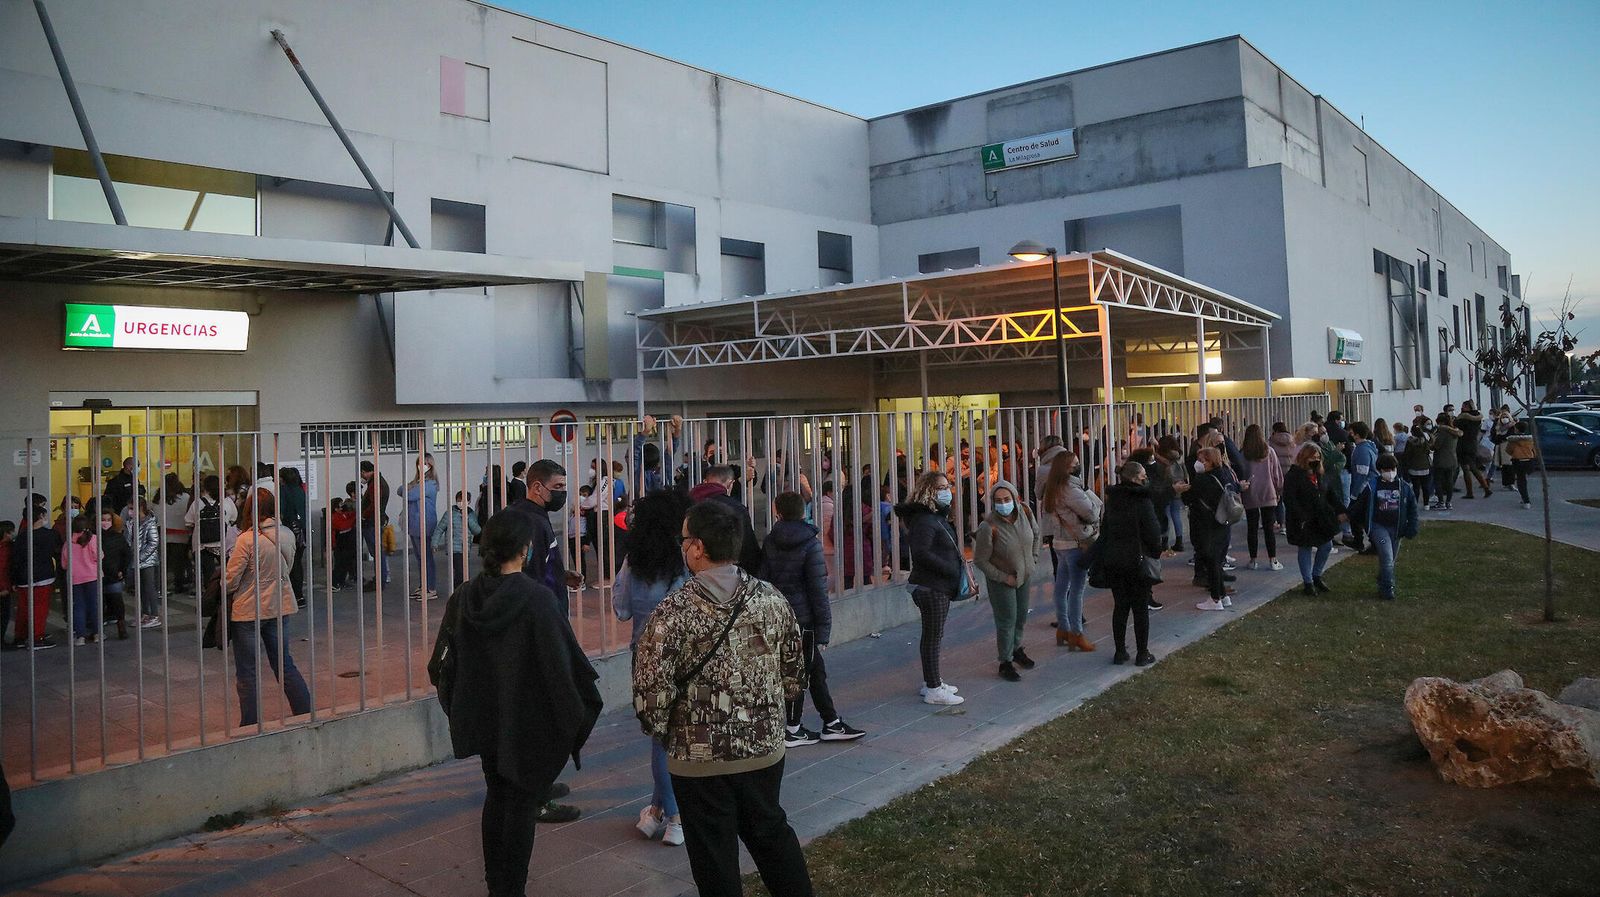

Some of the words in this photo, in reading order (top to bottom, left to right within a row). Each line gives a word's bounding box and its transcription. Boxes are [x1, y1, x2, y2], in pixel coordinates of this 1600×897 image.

[1007, 145, 1030, 154] Centro
[1030, 142, 1039, 150] de
[1039, 138, 1059, 148] Salud
[124, 321, 218, 337] URGENCIAS
